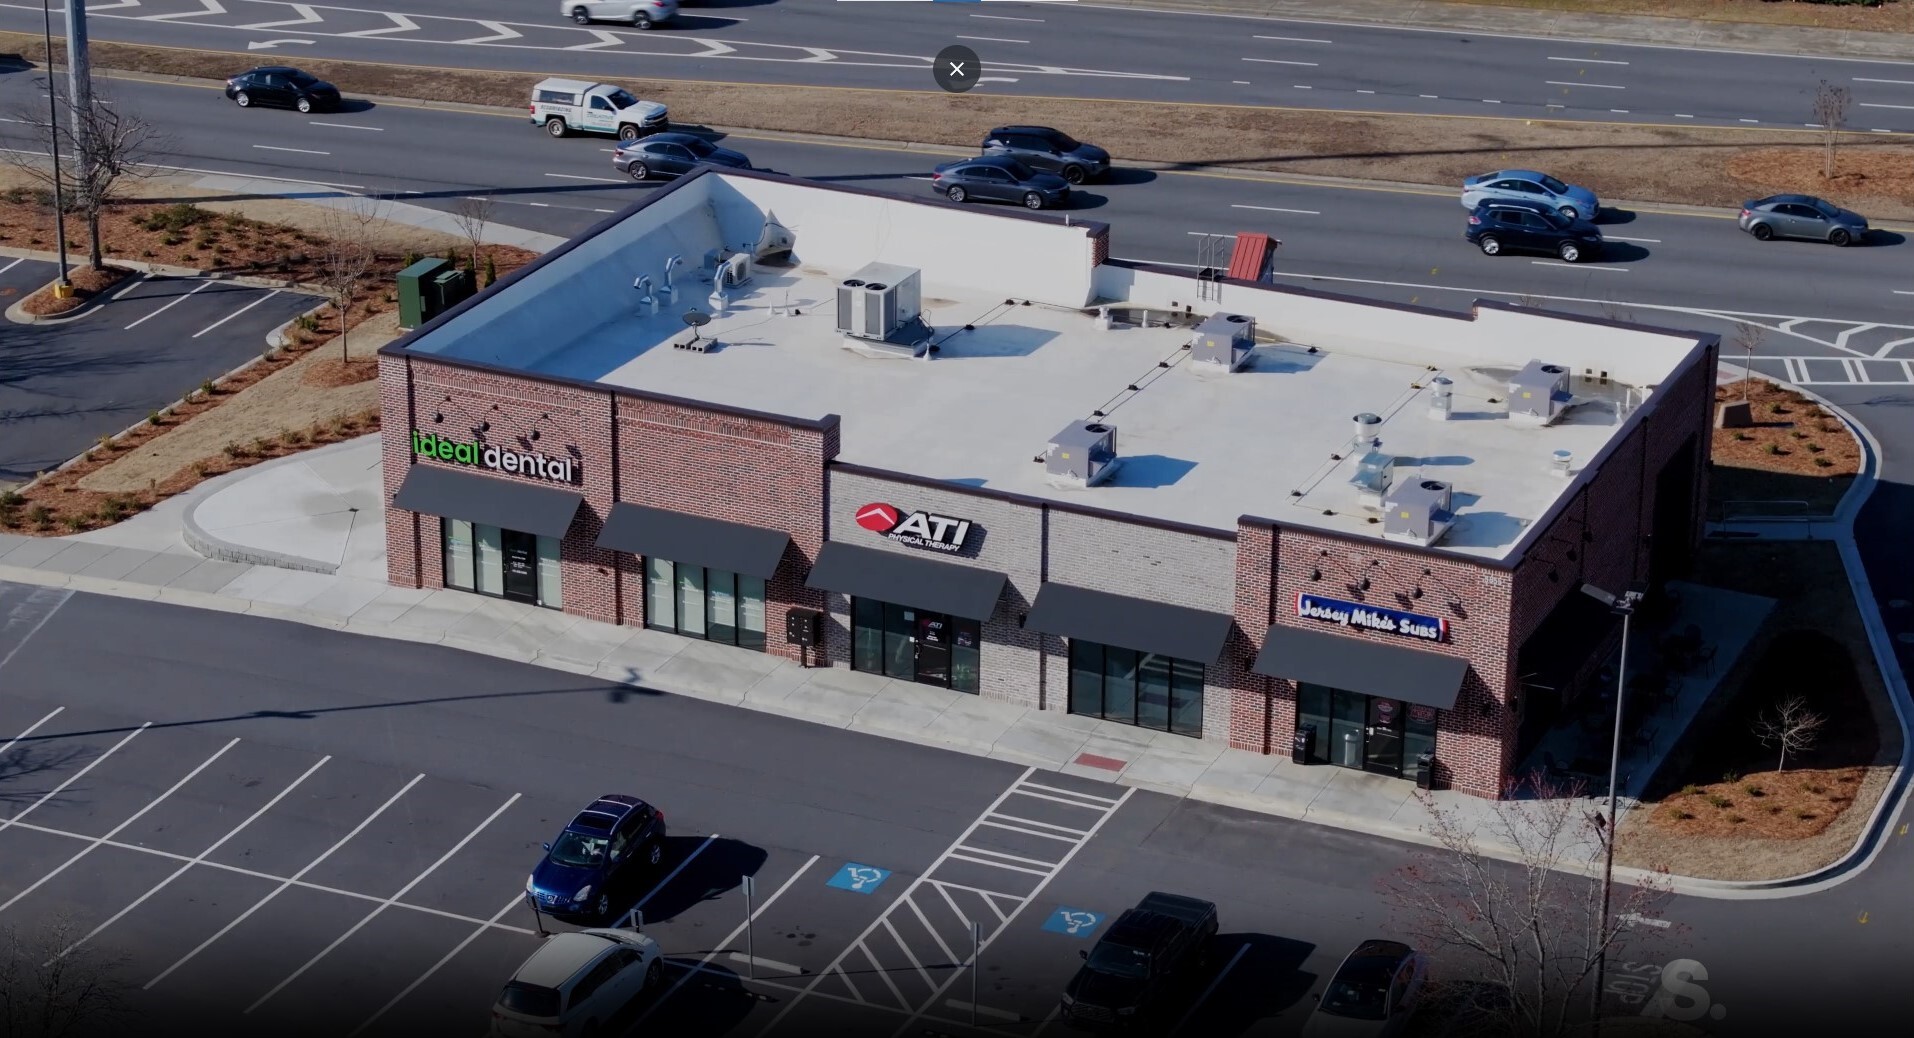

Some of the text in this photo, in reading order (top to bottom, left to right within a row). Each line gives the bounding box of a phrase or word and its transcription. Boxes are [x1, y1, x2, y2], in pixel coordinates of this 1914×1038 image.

[412, 431, 572, 482] ideal dental
[888, 533, 960, 552] PHYSICAL THERAPY
[893, 512, 970, 545] ATI
[1300, 600, 1349, 626] Jersey
[1351, 609, 1396, 631] Mike's
